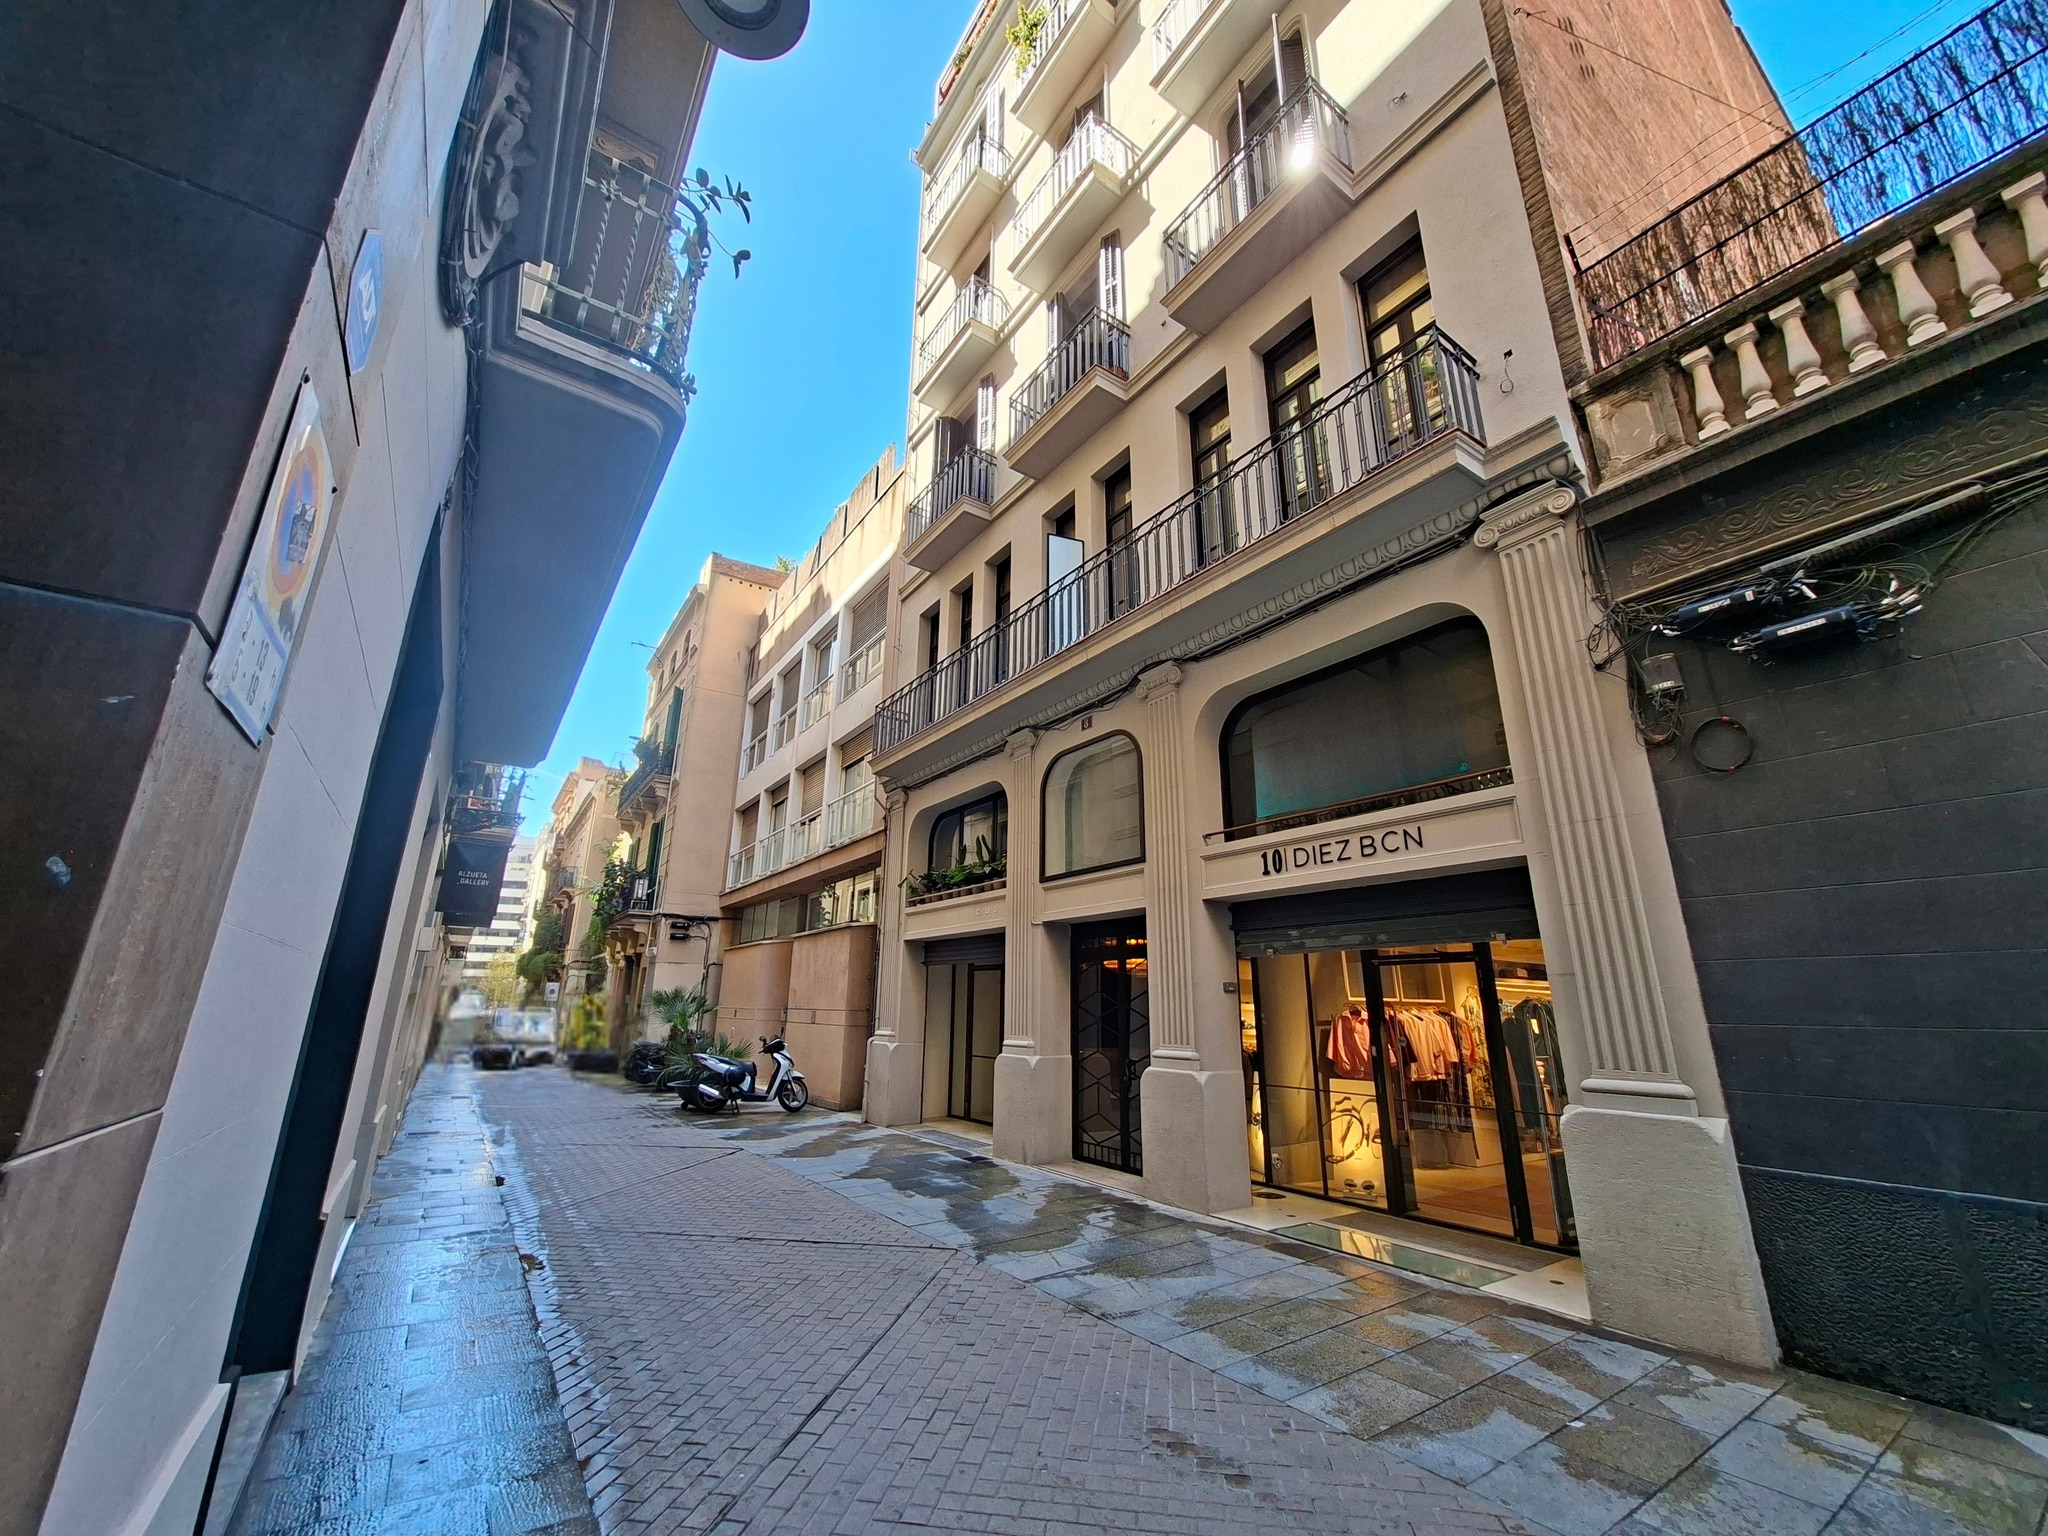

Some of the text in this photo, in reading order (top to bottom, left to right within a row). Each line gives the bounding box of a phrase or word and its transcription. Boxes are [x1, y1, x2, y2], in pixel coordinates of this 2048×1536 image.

[256, 638, 269, 672] 13
[1359, 825, 1424, 858] BCN
[458, 870, 488, 879] ALZUETA
